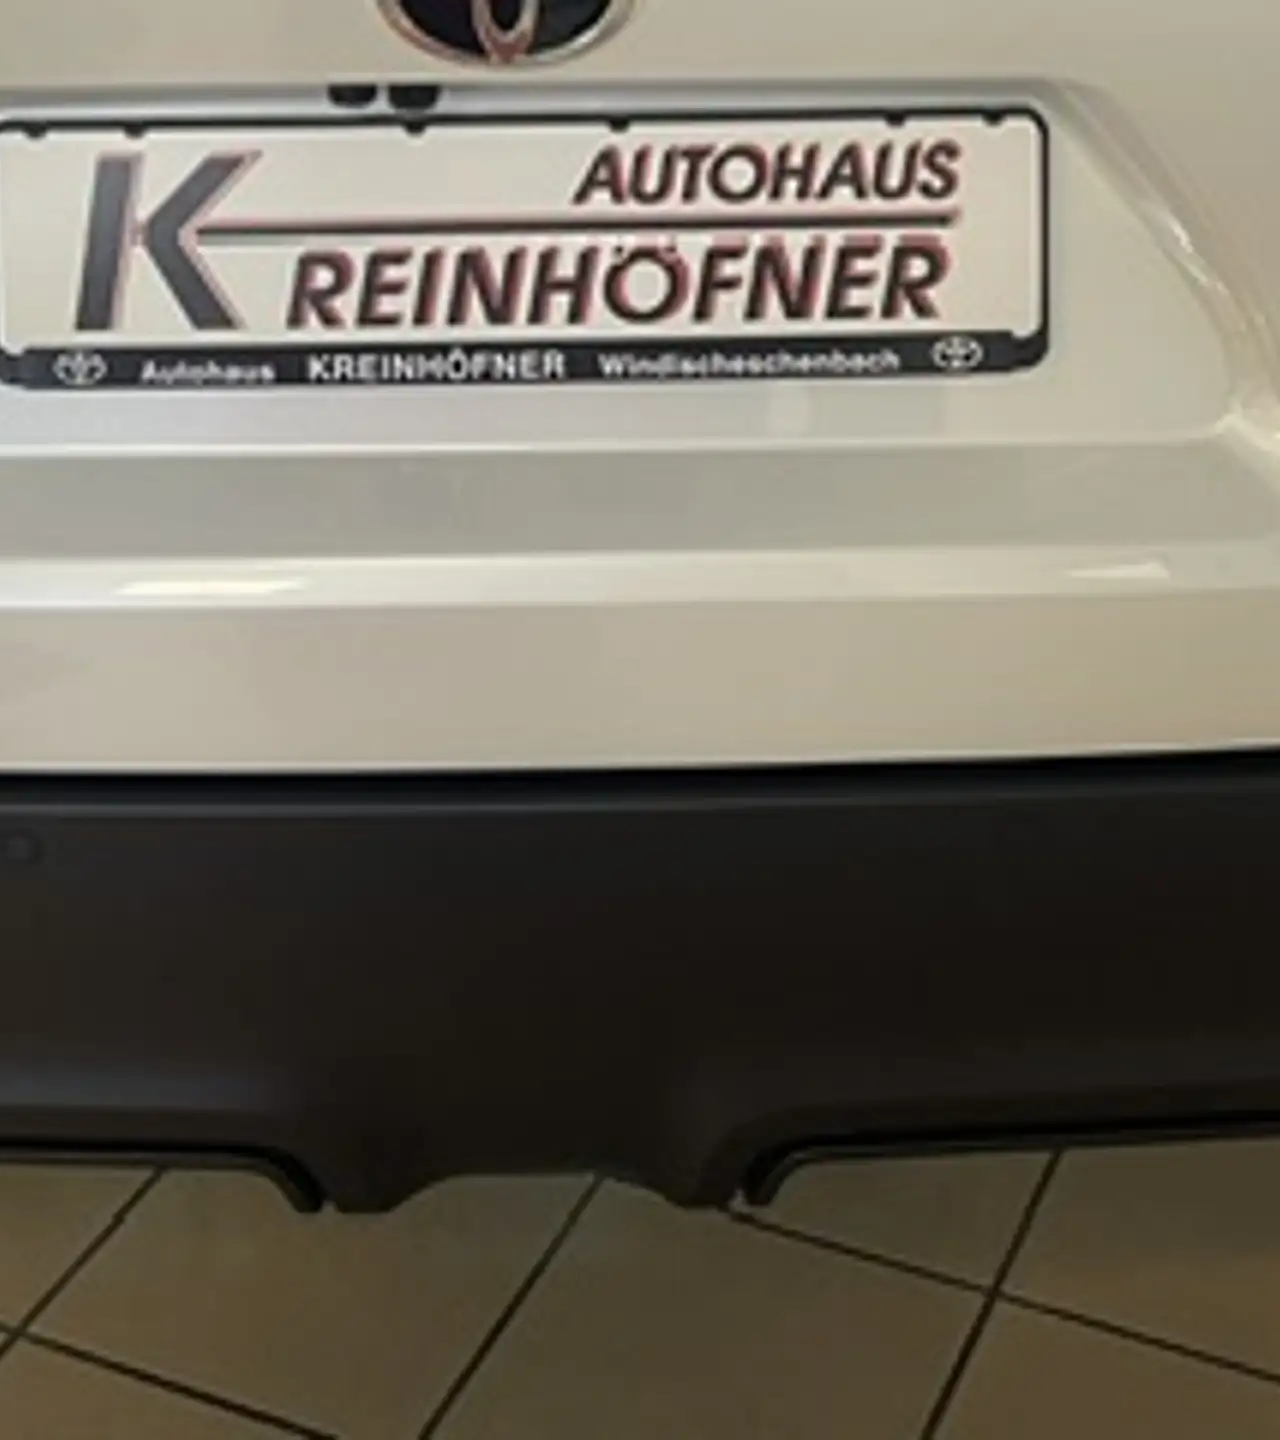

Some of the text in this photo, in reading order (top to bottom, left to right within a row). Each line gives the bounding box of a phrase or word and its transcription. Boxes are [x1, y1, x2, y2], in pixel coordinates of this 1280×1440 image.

[570, 137, 964, 207] AUTOHAUS
[138, 358, 278, 386] Autohaus
[307, 347, 565, 383] KREINHÖFNER
